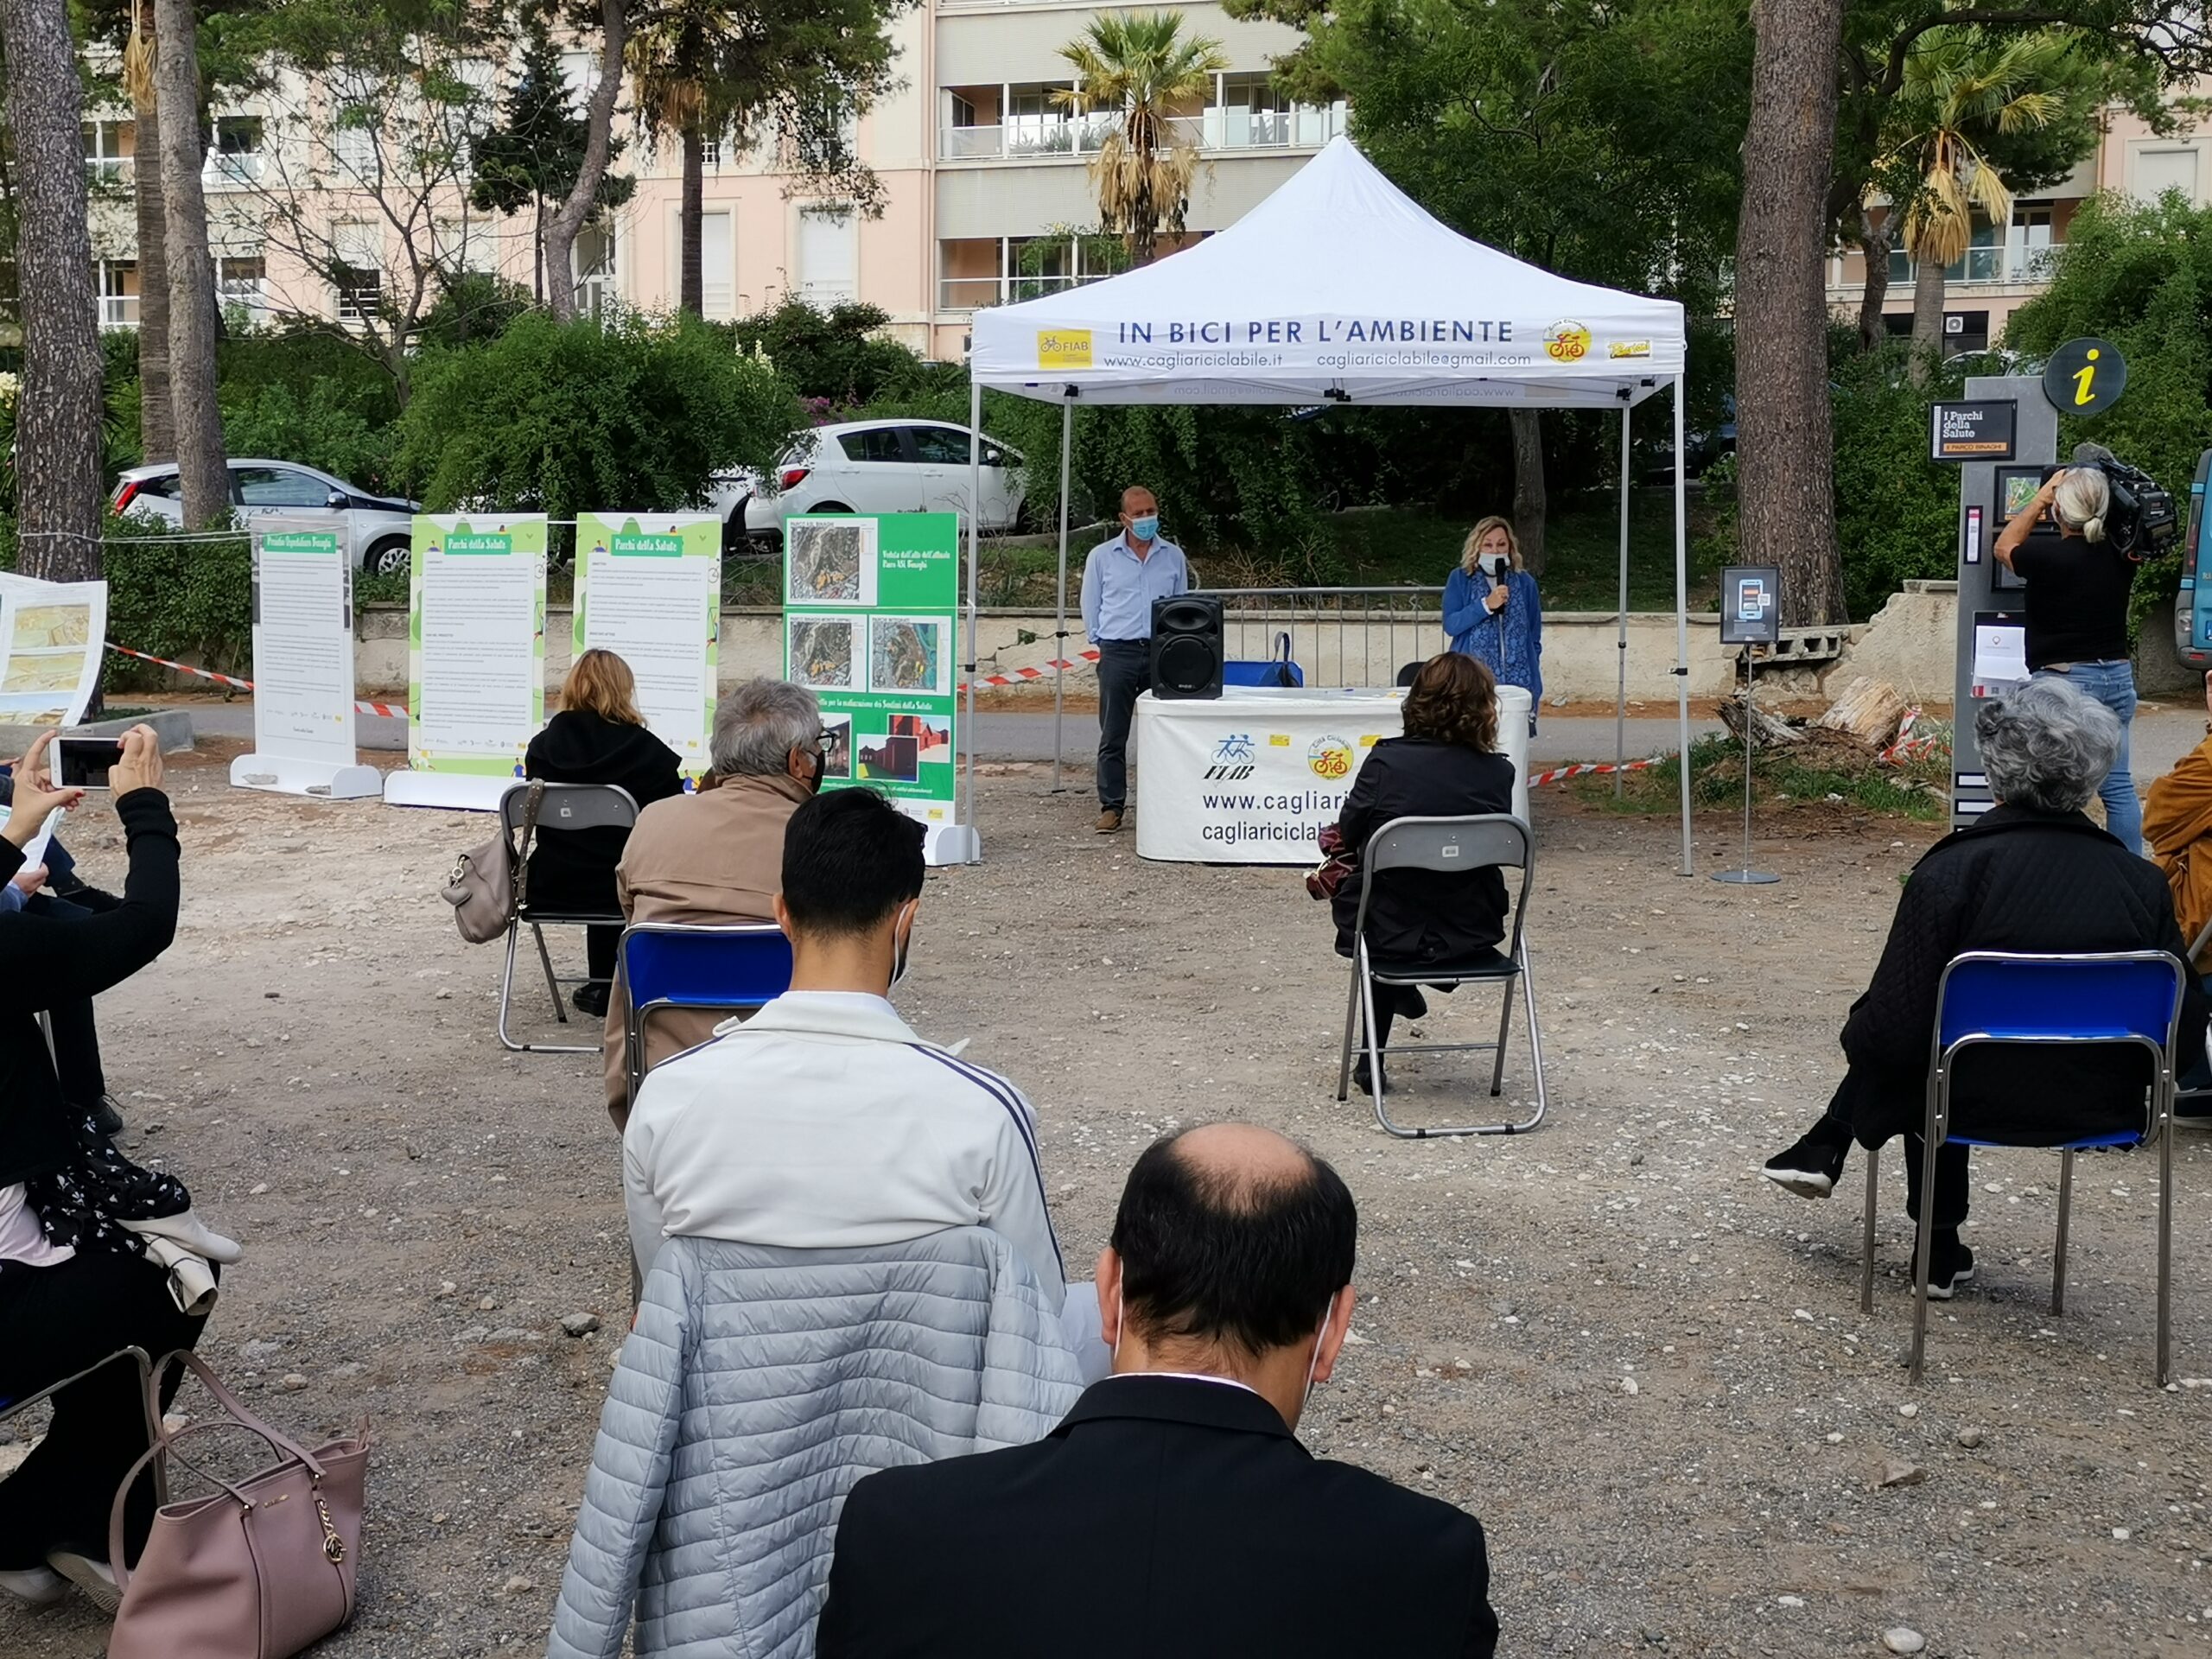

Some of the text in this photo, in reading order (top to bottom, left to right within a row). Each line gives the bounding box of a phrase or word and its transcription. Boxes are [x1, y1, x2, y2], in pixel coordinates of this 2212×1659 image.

[1120, 321, 1512, 343] IN BICI PER L'AMBIENTE
[1063, 340, 1089, 352] FIAB
[1103, 352, 1282, 371] www.cagliariciclabile.it
[1317, 351, 1531, 369] cagliariciclabile@gmail.com
[1943, 410, 1983, 421] I Parchi
[1943, 420, 1970, 429] della
[448, 537, 506, 550] Parchi della Salute
[615, 538, 677, 551] Parchi della Salute
[1202, 765, 1255, 780] FIAB
